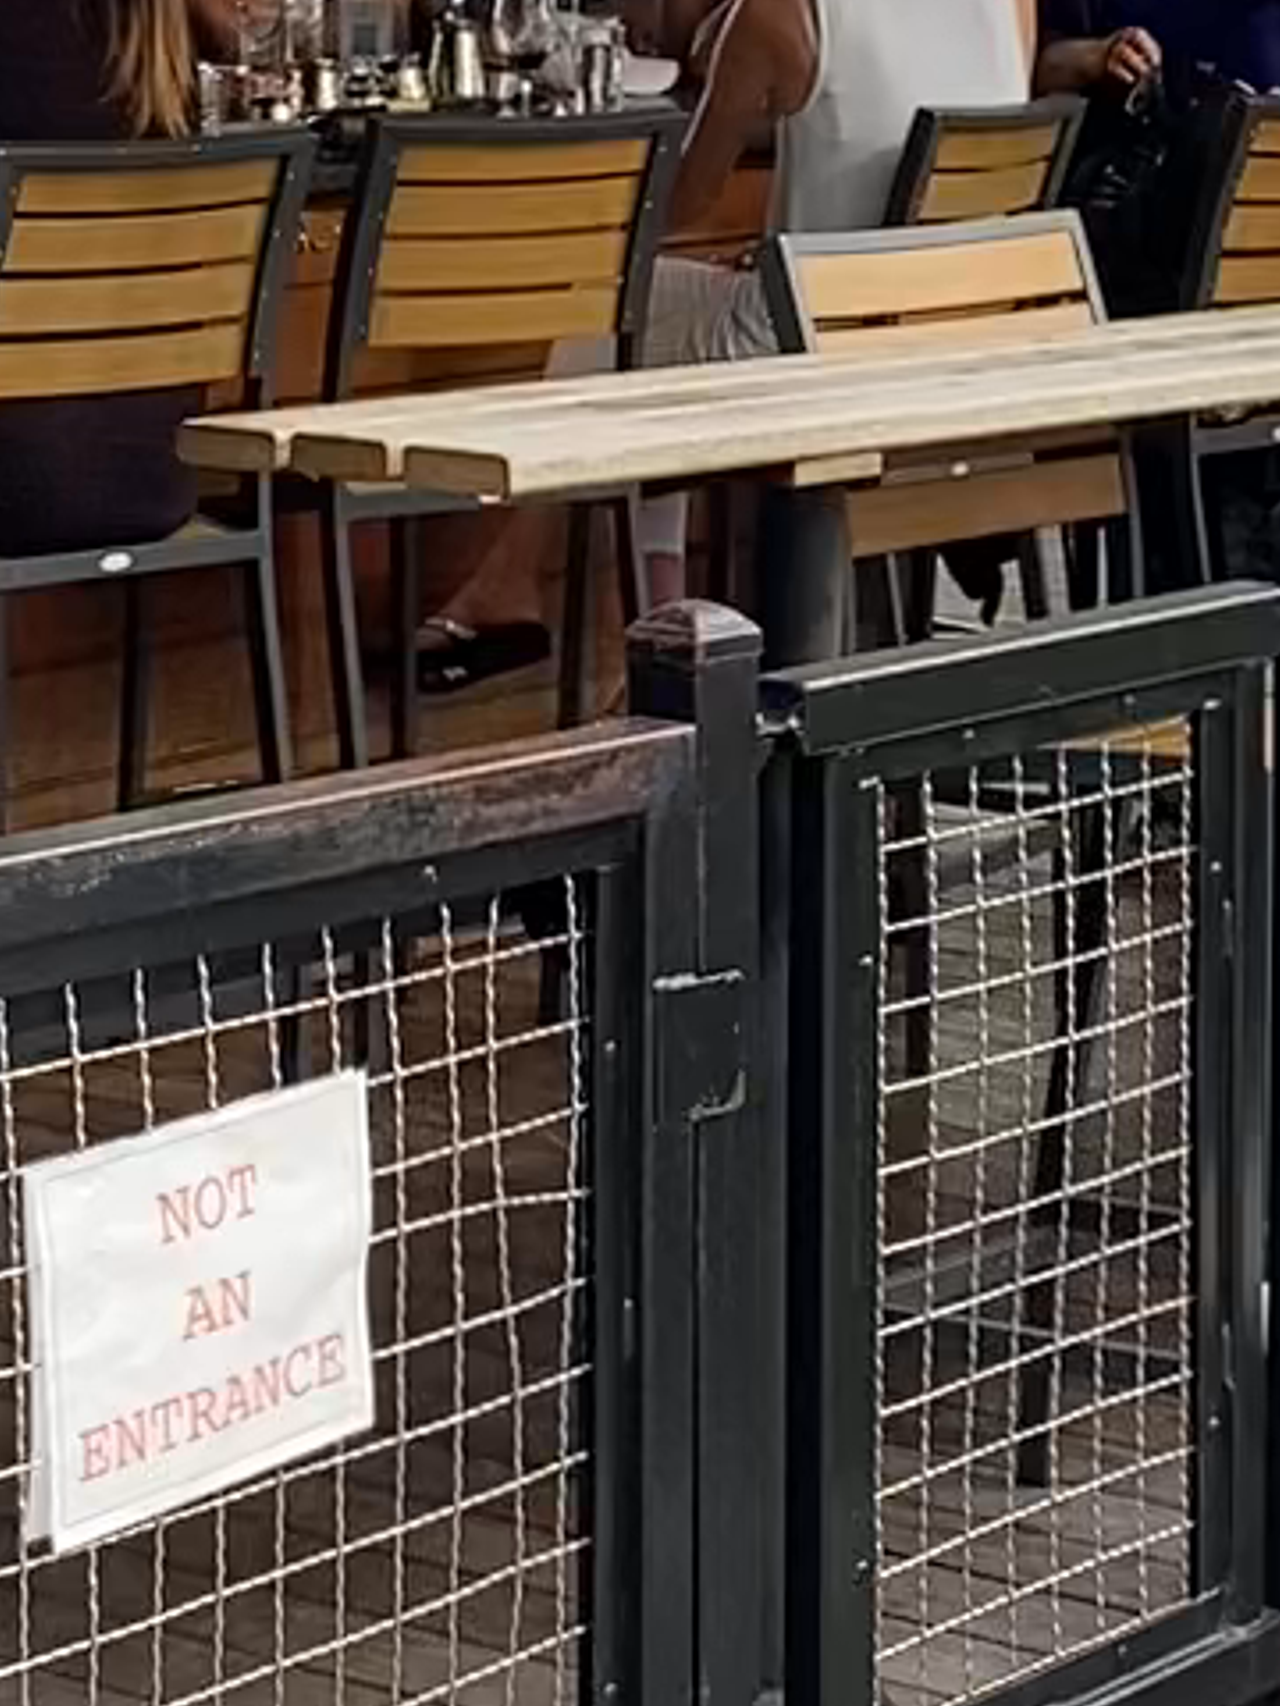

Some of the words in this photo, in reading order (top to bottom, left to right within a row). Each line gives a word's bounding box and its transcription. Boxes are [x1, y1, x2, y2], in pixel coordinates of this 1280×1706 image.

[155, 1163, 257, 1244] NOT
[182, 1271, 252, 1342] AN
[78, 1333, 346, 1482] ENTRANCE
